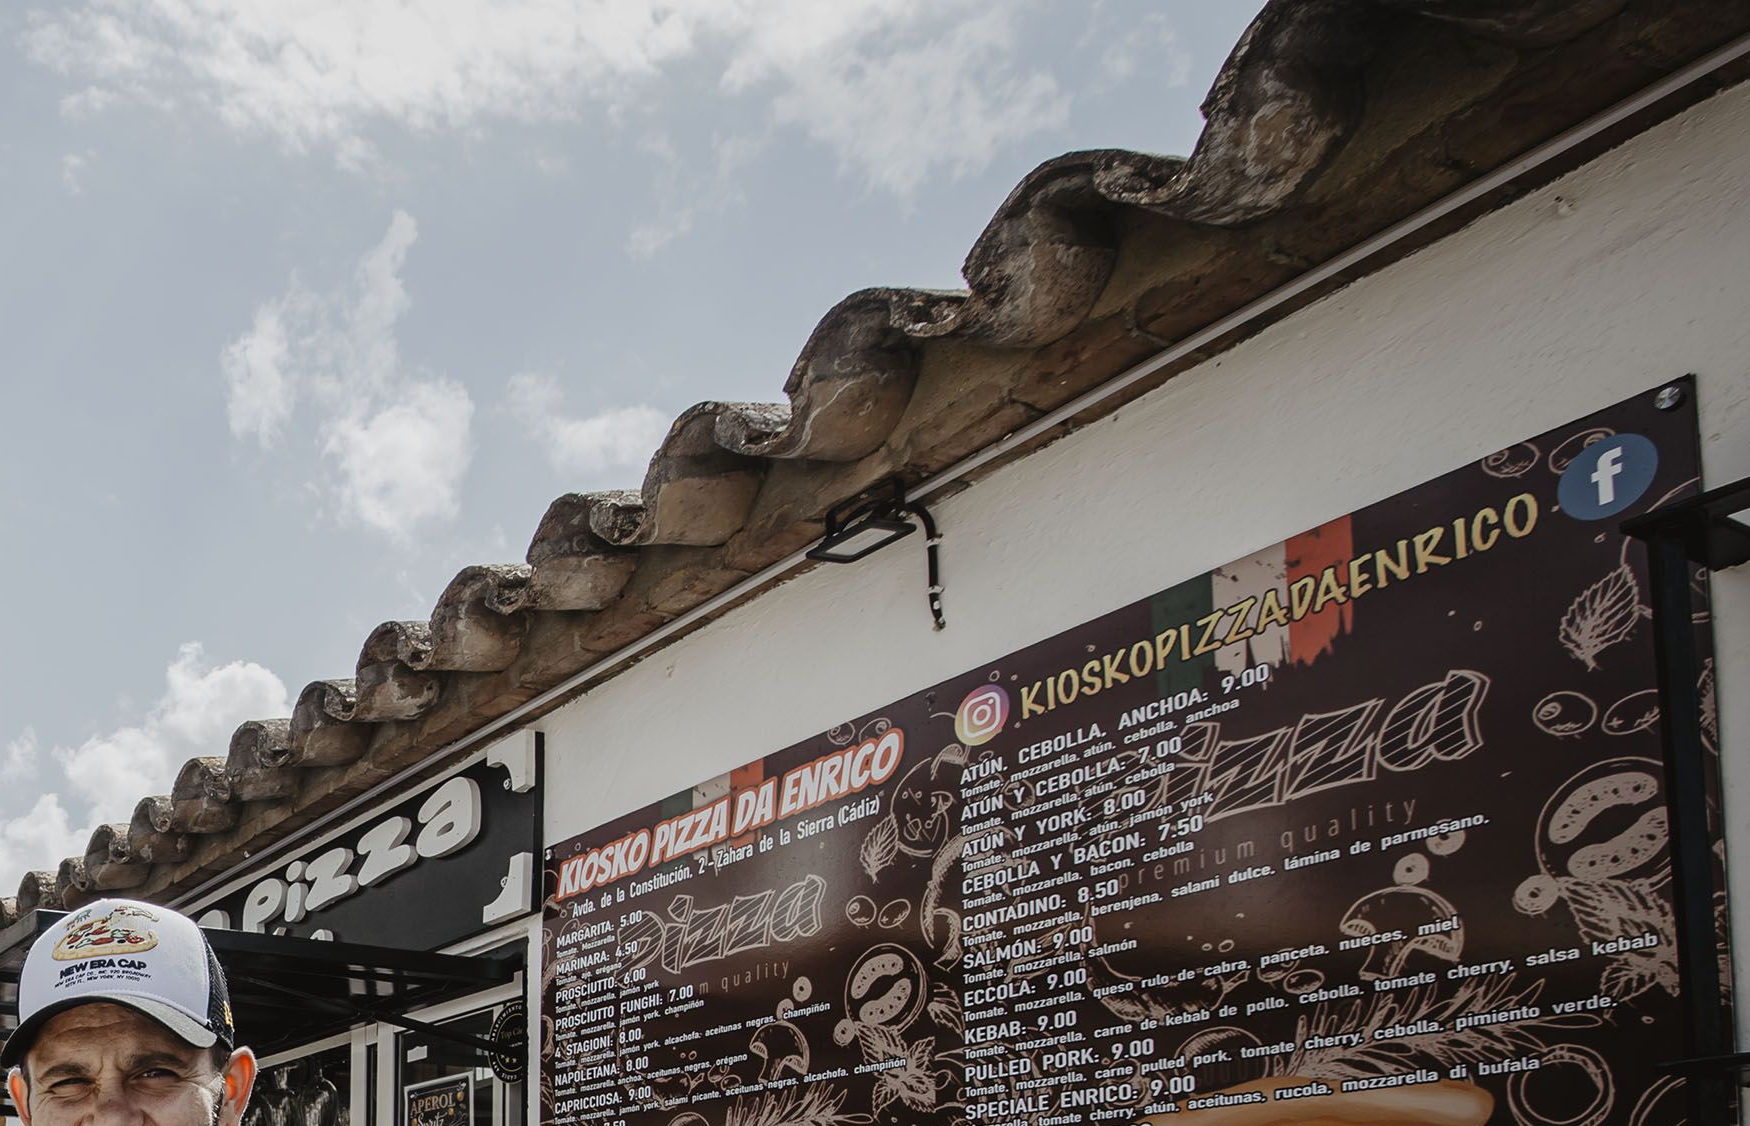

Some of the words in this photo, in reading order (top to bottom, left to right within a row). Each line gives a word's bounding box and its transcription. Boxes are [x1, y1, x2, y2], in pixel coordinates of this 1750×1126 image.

[1020, 492, 1539, 720] KIOSKOPIZZADAENRICO
[1118, 688, 1208, 730] ANCHOA:
[1221, 663, 1269, 694] 9.00
[556, 829, 650, 900] KIOSKO
[650, 797, 730, 865] PIZZA
[732, 780, 775, 835] DA
[779, 730, 902, 819] ENRICO
[572, 900, 596, 918] Avda.
[601, 893, 612, 908] de
[617, 888, 625, 902] la
[698, 857, 705, 874] 2
[716, 843, 753, 868] Zahara
[759, 834, 773, 853] de
[780, 828, 790, 846] la
[797, 815, 834, 840] Sierra
[838, 794, 880, 827] (Cádiz)
[962, 860, 1040, 894] CEBOLLA
[1051, 853, 1062, 869] Y
[1073, 831, 1146, 865] BACON:
[1158, 815, 1204, 843] 7.50
[556, 920, 614, 948] MARGARITA:
[620, 910, 642, 928] 5.00
[962, 894, 1066, 932] CONTADINO:
[1077, 879, 1119, 904] 8.50
[60, 962, 88, 979] NEW
[90, 959, 115, 969] ERA
[118, 959, 147, 970] CAP
[555, 1005, 614, 1031] PROSCIUTTO
[620, 994, 663, 1014] FUNGHI:
[669, 984, 693, 1002] 7.00
[555, 1047, 561, 1059] 4
[566, 1035, 613, 1056] STAGIONI:
[619, 1028, 642, 1044] 8.00
[965, 1059, 1031, 1082] PULLED
[1043, 1048, 1099, 1071] PORK:
[1112, 1038, 1154, 1060] 9.00
[410, 1092, 455, 1118] APEROL
[965, 1095, 1050, 1120] SPECIALE
[1061, 1083, 1137, 1108] ENRICO:
[1150, 1075, 1195, 1096] 9.00
